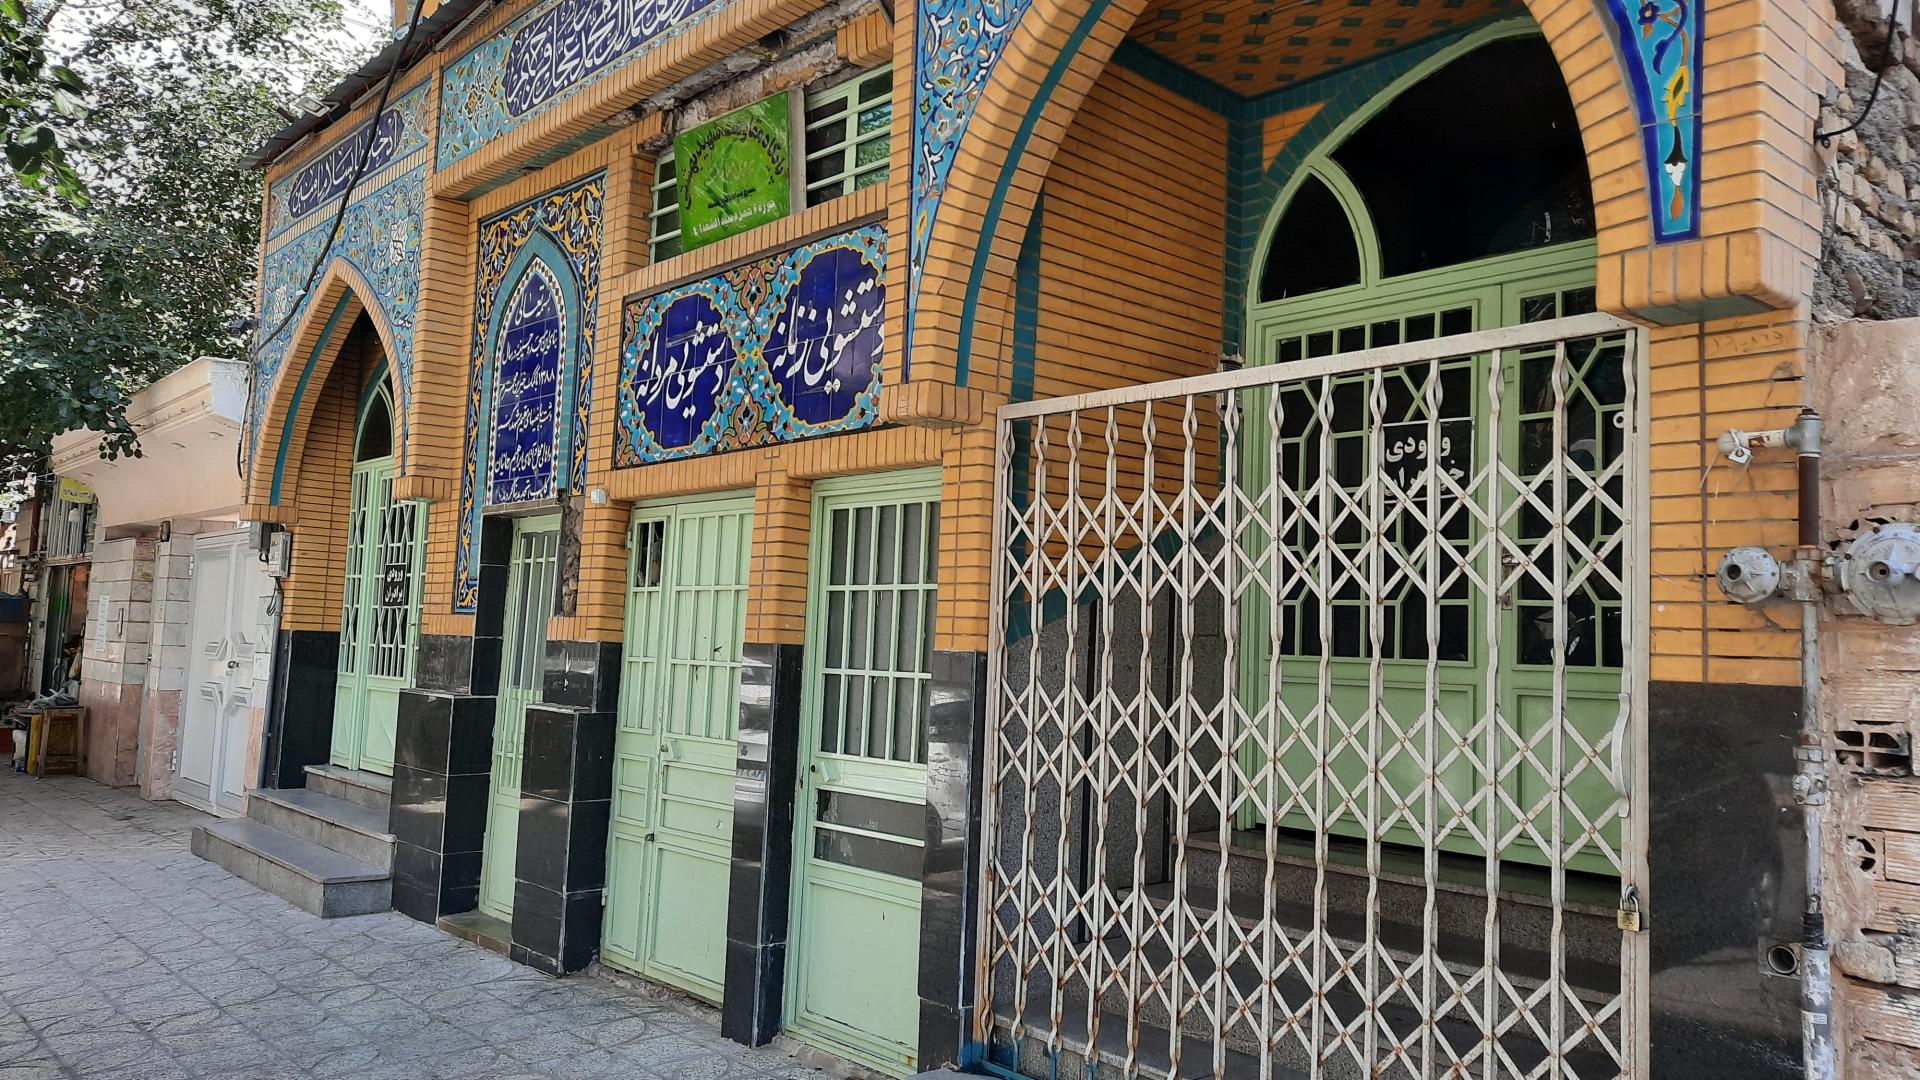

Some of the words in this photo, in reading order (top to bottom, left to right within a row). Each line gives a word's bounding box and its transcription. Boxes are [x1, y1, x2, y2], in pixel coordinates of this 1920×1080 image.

[637, 332, 678, 406] مردانه
[666, 321, 727, 419] دستشویی
[772, 295, 819, 379] زنانه
[802, 279, 885, 395] دستشویی
[1386, 436, 1451, 463] وودی
[384, 585, 403, 601] برادران
[386, 568, 403, 581] ورودی
